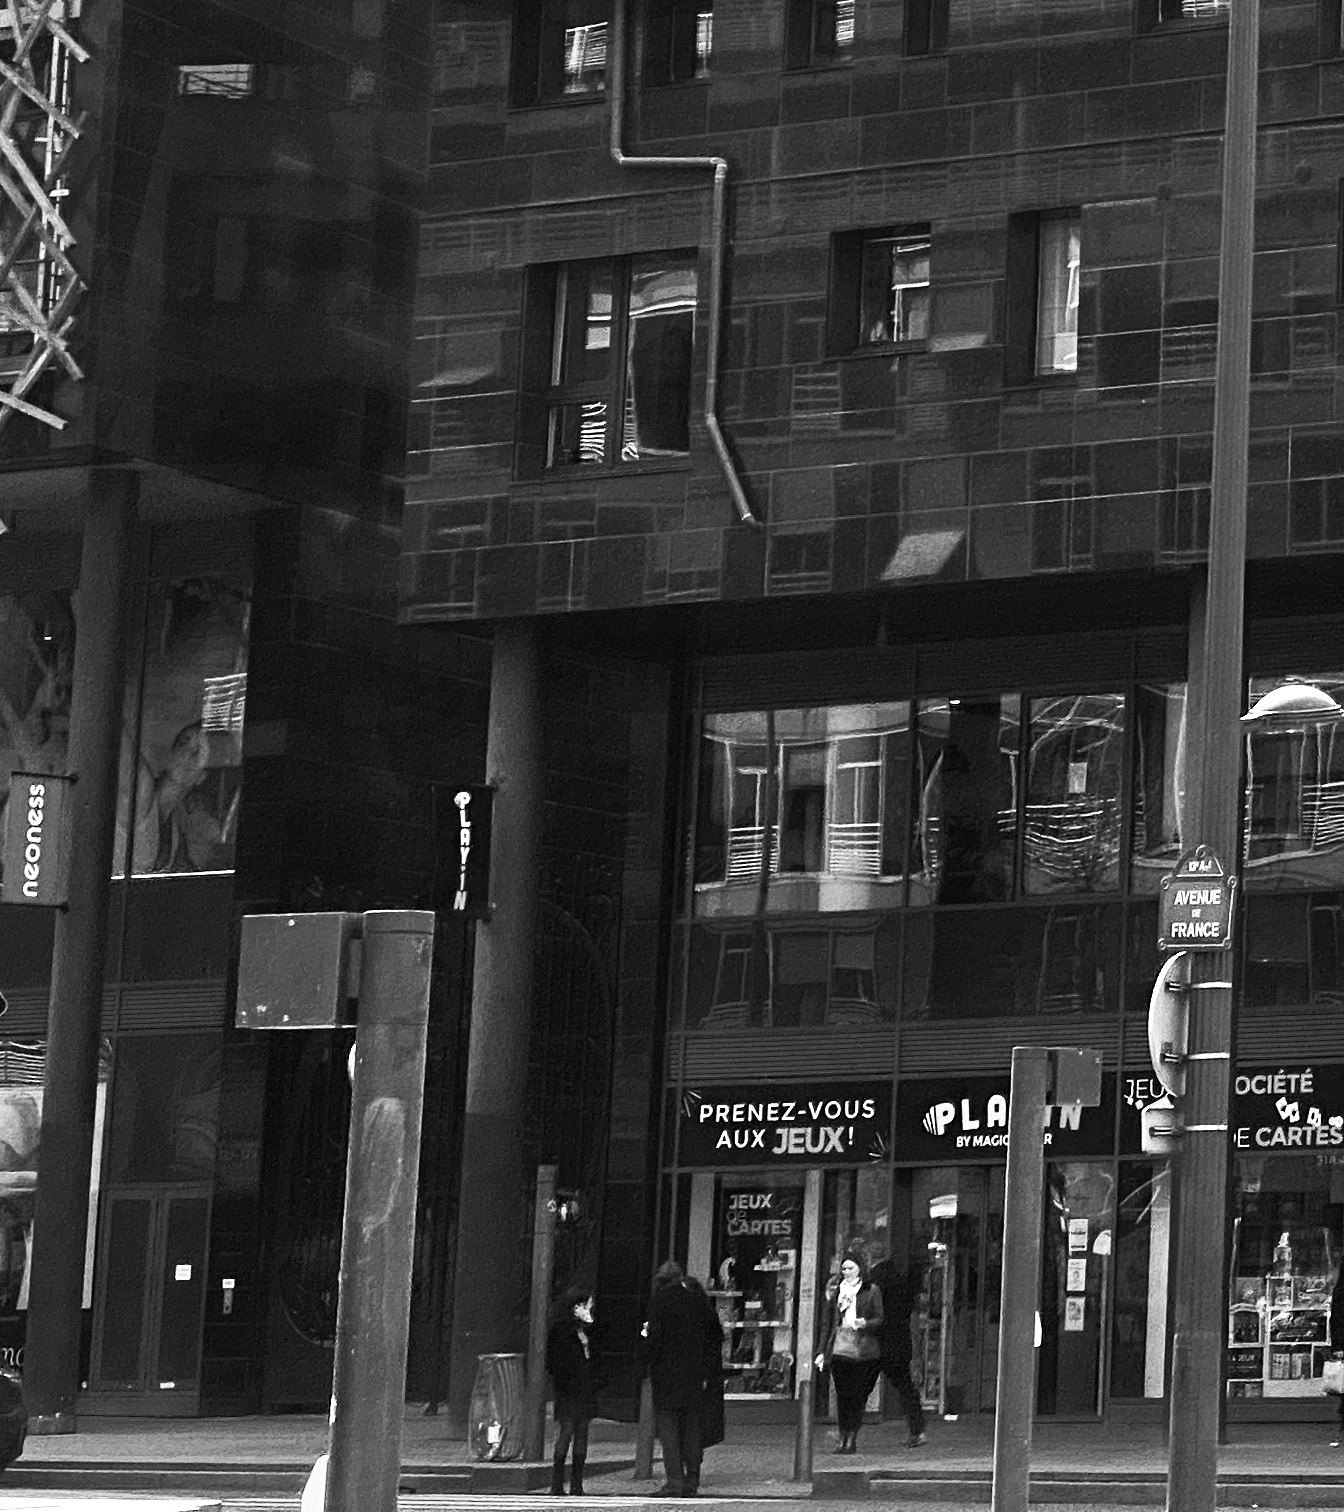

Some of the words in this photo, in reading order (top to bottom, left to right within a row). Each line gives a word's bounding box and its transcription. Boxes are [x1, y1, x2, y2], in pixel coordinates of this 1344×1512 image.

[22, 784, 45, 898] neoness
[1173, 889, 1221, 906] AVENUE
[1170, 922, 1221, 938] FRANCE
[1235, 1068, 1314, 1096] OCIÉTÉ
[699, 1099, 876, 1124] PRENEZ-VOUS
[715, 1128, 766, 1150] AUX
[956, 1135, 971, 1148] BY
[1233, 1127, 1251, 1149] E
[1255, 1126, 1344, 1148] CARTES
[728, 1193, 773, 1210] JEUX
[727, 1219, 792, 1237] CARTES
